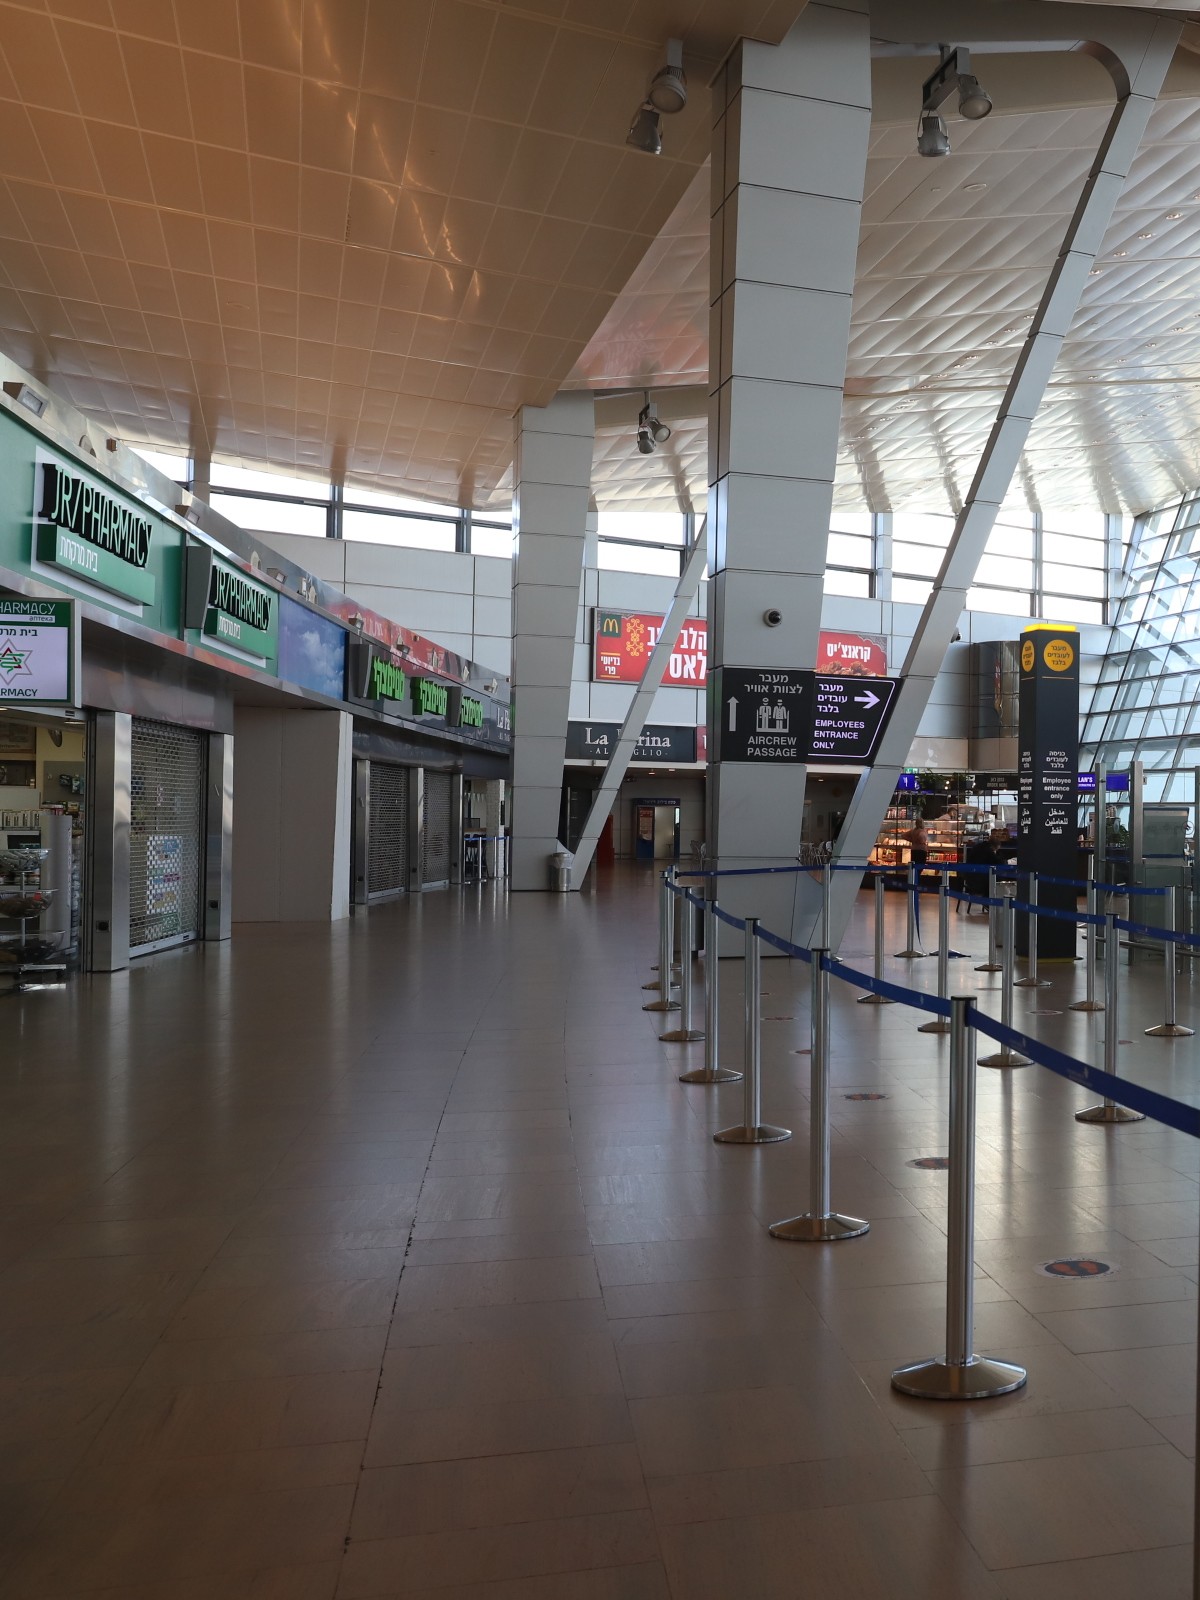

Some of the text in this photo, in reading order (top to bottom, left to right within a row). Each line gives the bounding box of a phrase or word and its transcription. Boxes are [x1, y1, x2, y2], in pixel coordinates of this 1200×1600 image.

[50, 464, 153, 569] JR/PHARMACY
[85, 549, 98, 573] בית
[214, 566, 272, 632] JR/PHARMACY
[605, 666, 616, 675] פרי
[759, 674, 789, 683] מעבר
[744, 683, 803, 694] לצוות אוויר
[819, 683, 844, 692] מעבר
[817, 694, 848, 704] עובדים
[817, 704, 839, 713] בלבד
[815, 719, 865, 729] EMPLOYEES
[585, 727, 671, 748] La rina
[814, 730, 859, 740] ENTRANCE
[747, 735, 797, 746] AIRCREW
[813, 741, 835, 749] ONLY
[595, 747, 609, 755] AL
[747, 747, 797, 757] PASSAGE
